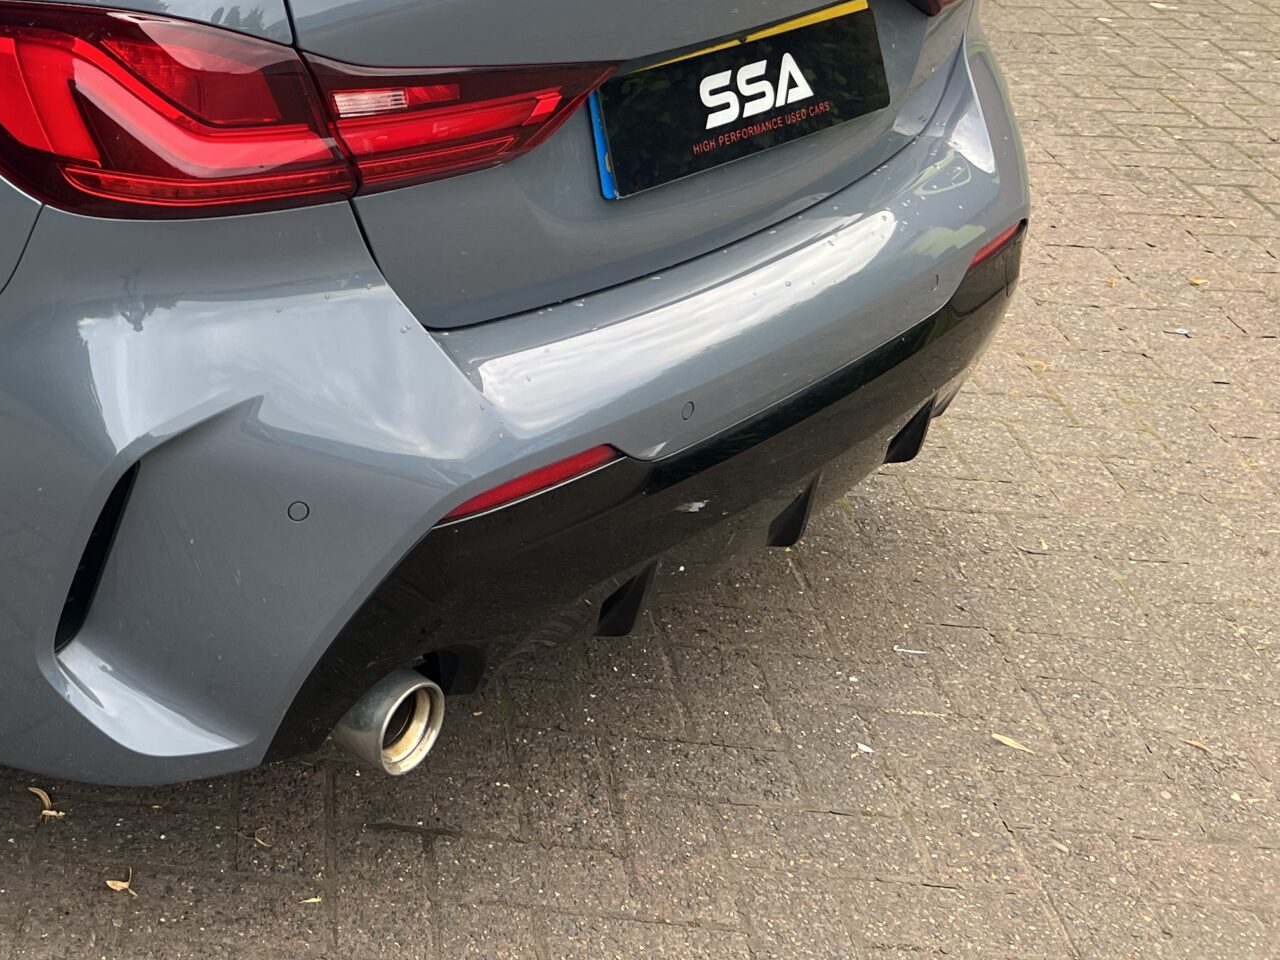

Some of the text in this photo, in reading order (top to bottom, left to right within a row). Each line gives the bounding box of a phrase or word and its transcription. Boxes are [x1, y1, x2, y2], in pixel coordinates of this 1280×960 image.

[699, 52, 815, 130] SSA
[693, 100, 830, 154] HIGH PERFORMANCE USED CARS
